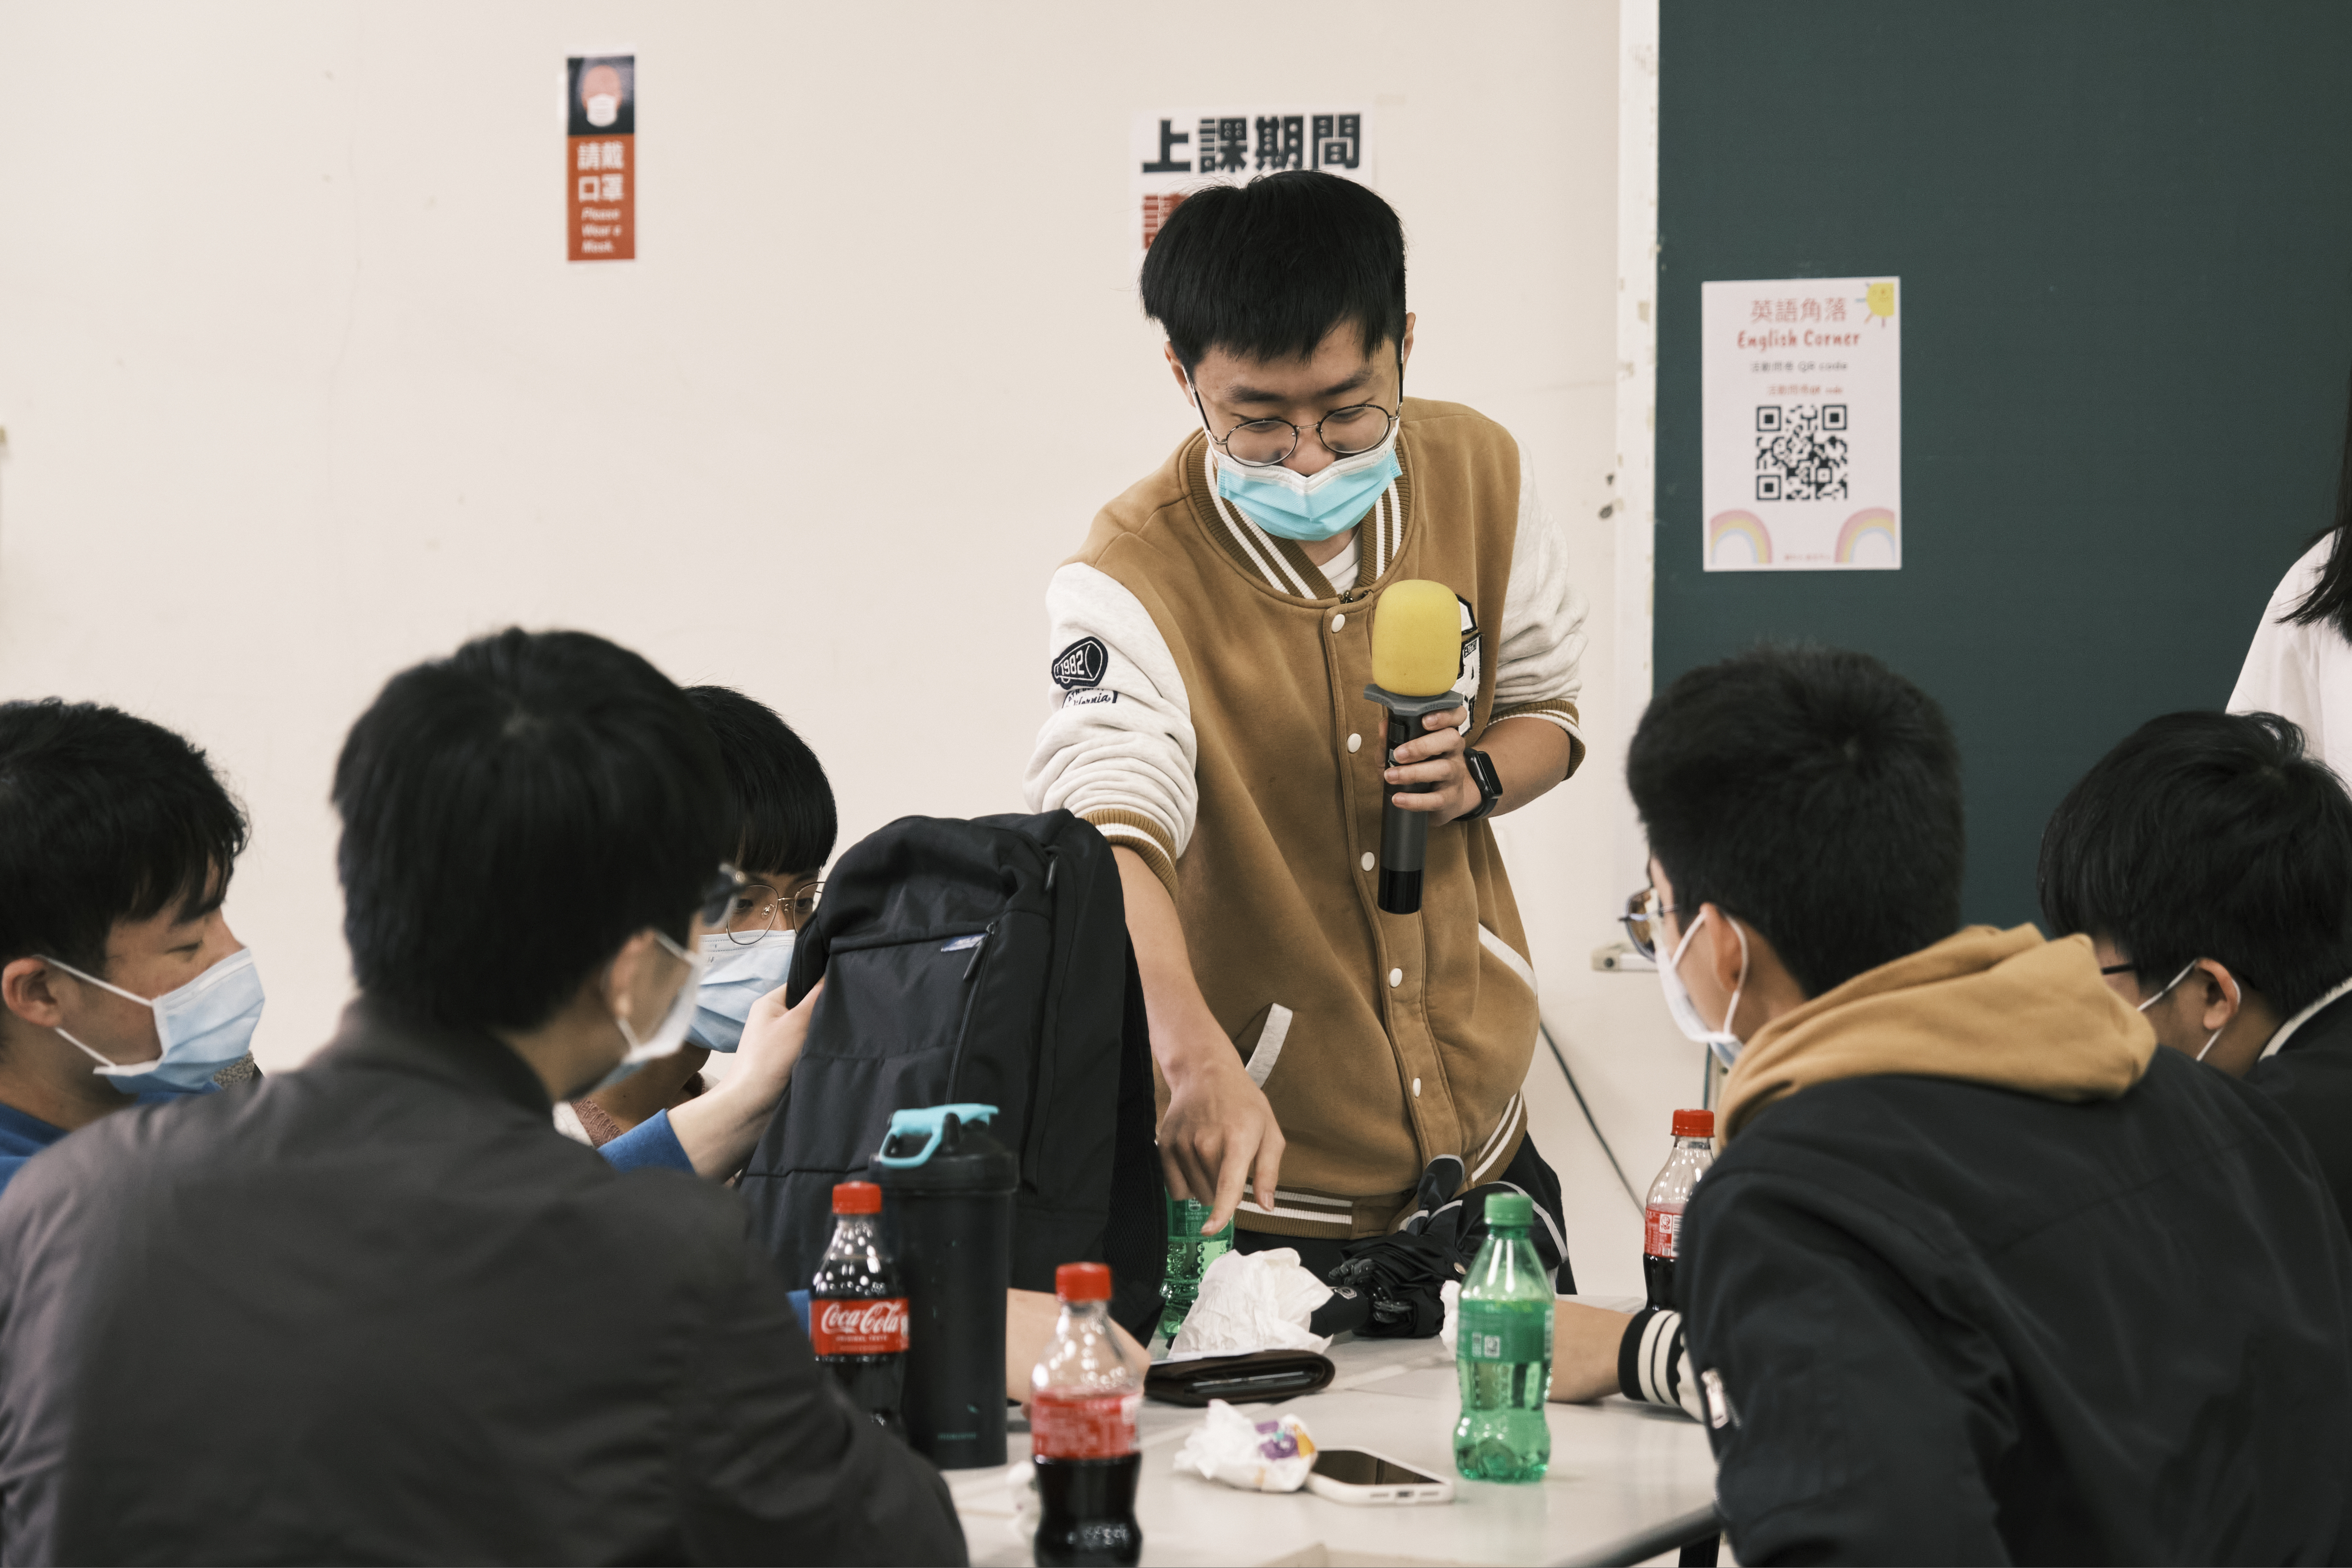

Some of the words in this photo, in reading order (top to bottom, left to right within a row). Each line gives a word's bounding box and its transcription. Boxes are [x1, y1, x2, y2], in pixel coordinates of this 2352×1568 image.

[578, 141, 624, 171] 請戴
[1141, 113, 1361, 173] 上課期間
[578, 173, 624, 202] 口罩
[1751, 298, 1846, 323] 英語角落
[1738, 328, 1797, 353] English
[1804, 328, 1859, 347] Corner
[1060, 650, 1085, 675] 1982
